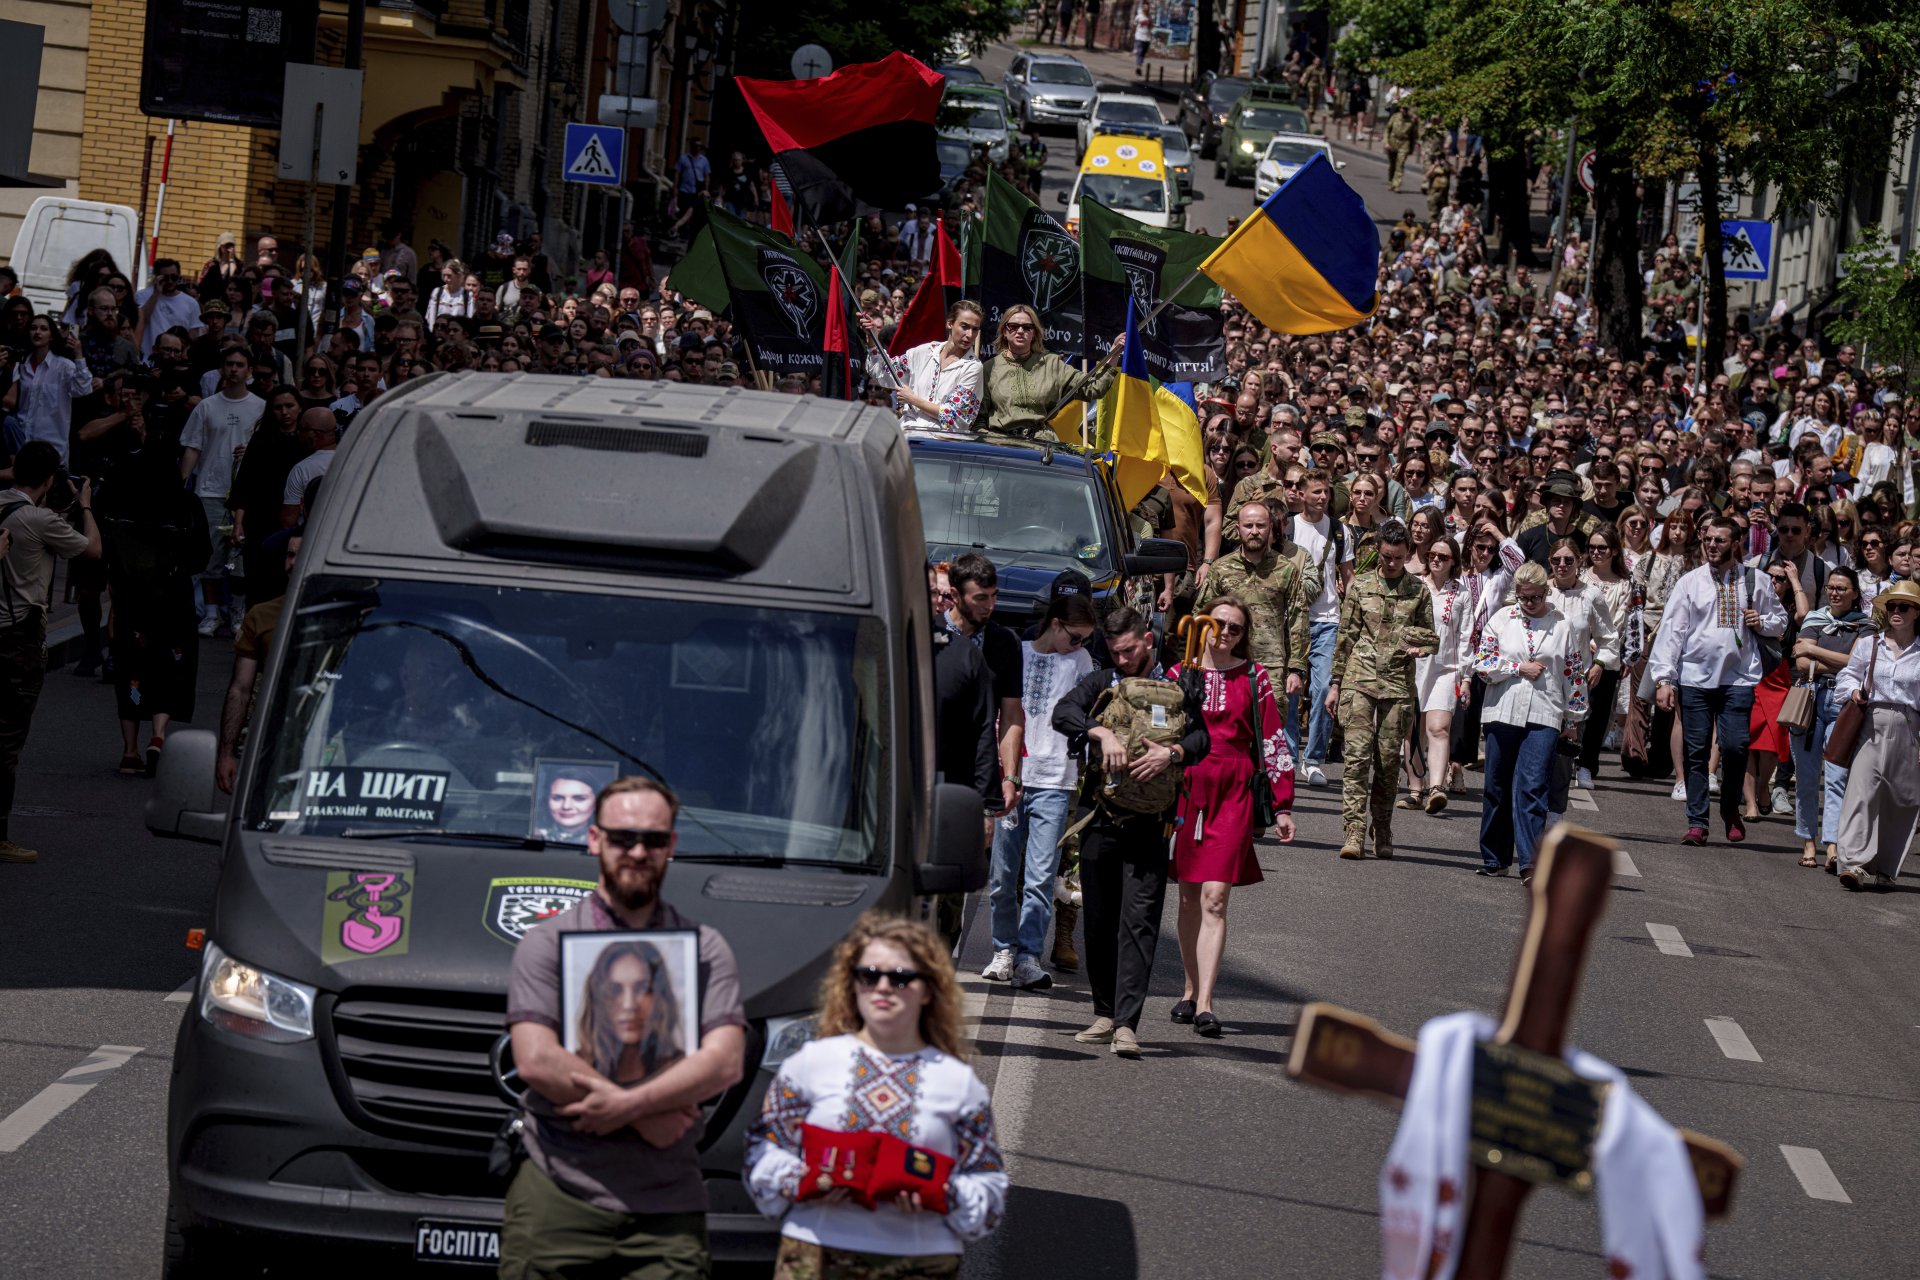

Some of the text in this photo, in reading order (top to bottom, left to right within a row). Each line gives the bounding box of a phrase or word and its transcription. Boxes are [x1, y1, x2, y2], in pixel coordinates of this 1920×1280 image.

[306, 771, 447, 802] НА ЩИТІ
[305, 804, 436, 821] ЕВАКУАЦІЯ ПОЛЕГЛИХ
[417, 1228, 501, 1259] ГОСПІТА
